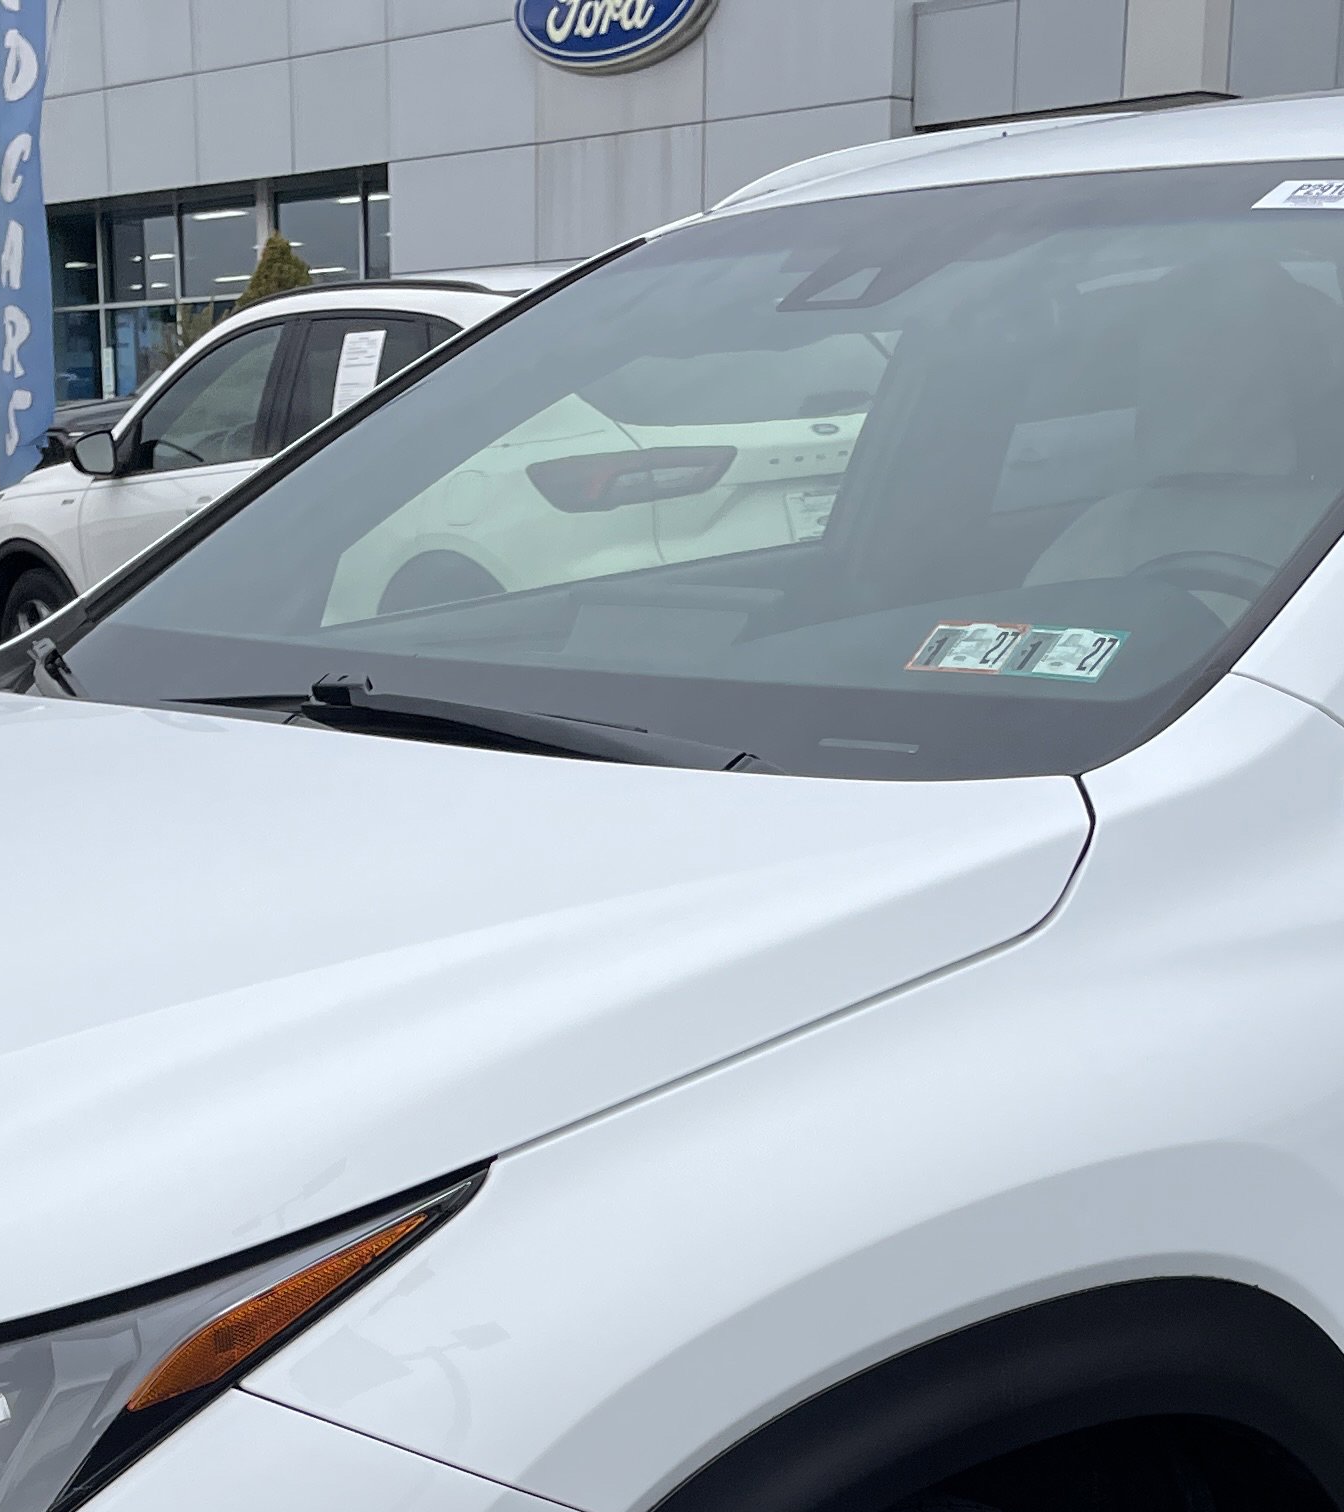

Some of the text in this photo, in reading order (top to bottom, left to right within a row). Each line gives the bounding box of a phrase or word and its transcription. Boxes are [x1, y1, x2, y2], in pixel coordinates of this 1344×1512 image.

[0, 133, 32, 456] CARS
[979, 631, 1021, 665] 27
[1076, 637, 1119, 672] 27
